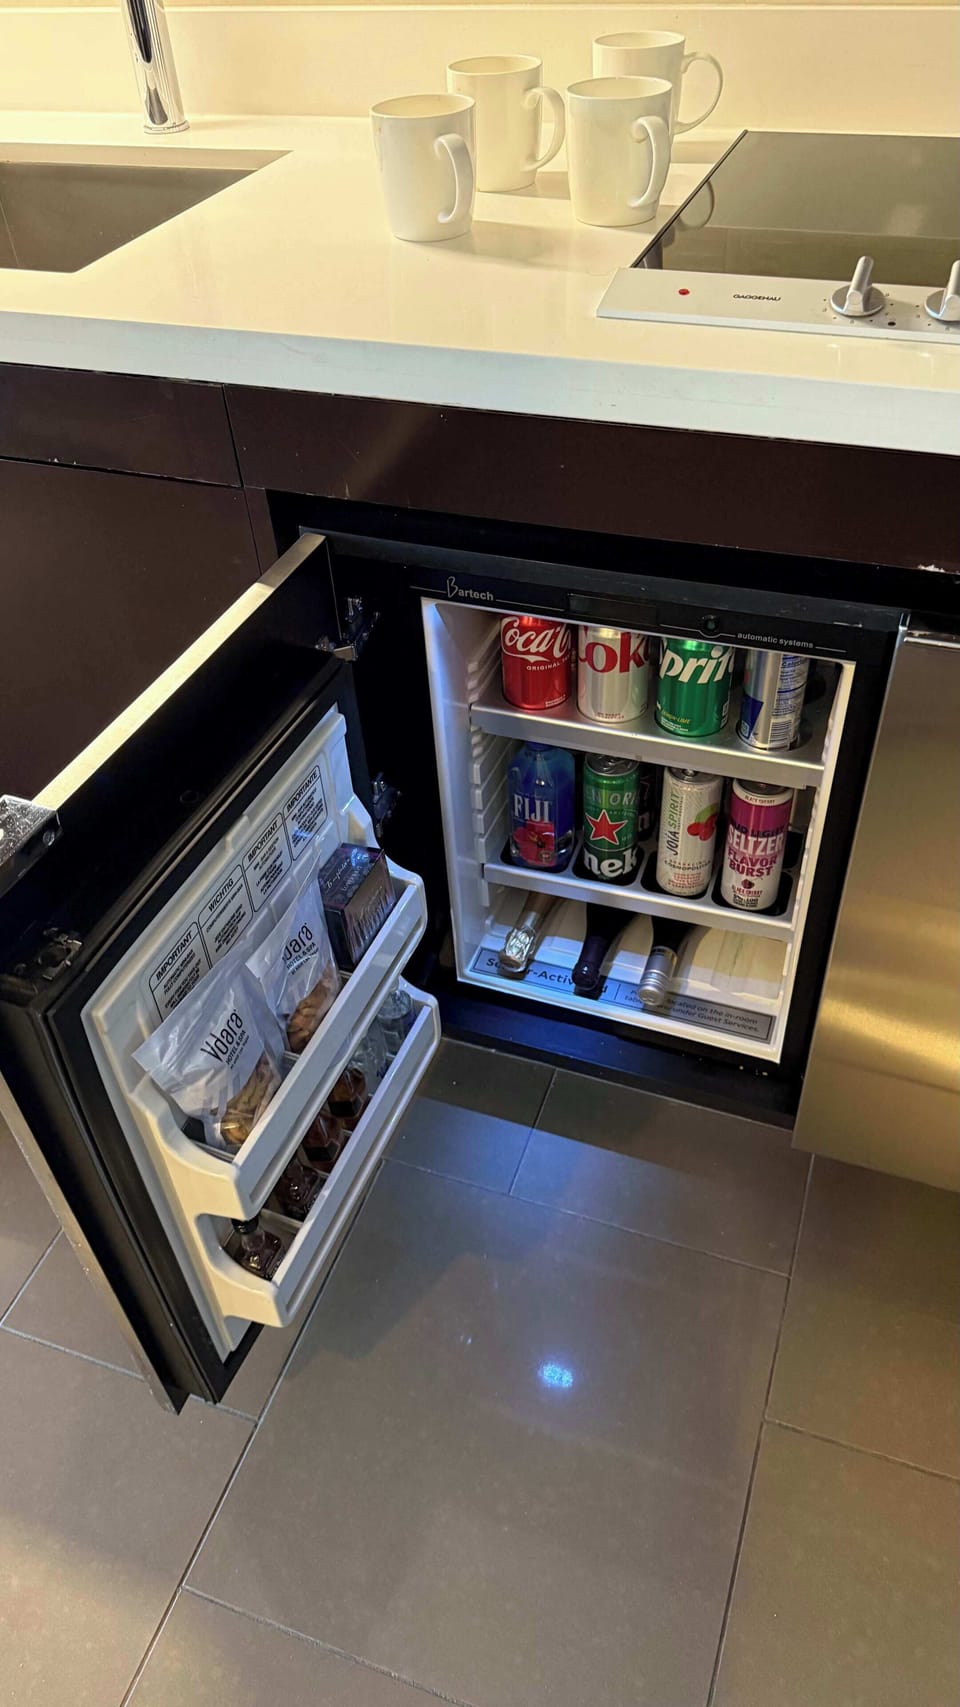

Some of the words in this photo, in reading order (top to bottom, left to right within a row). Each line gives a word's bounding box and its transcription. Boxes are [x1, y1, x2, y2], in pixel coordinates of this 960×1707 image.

[447, 576, 494, 601] Bartech
[578, 626, 649, 673] ok
[737, 632, 778, 644] automatic
[778, 639, 814, 649] systems
[526, 662, 561, 671] ORIGINAL
[659, 639, 735, 684] prit
[286, 769, 317, 813] IMPORTANTE
[513, 793, 551, 823] FIJI
[668, 791, 681, 830] SPIRIT
[247, 820, 278, 862] IMPORTANT
[728, 823, 784, 855] SELTZER
[728, 847, 777, 867] FLAVOR
[728, 859, 774, 877] BURST
[208, 878, 234, 912] WICHTIG
[155, 930, 192, 981] IMPORTANT
[709, 1007, 723, 1016] the
[200, 1011, 243, 1062] Vdara
[225, 1045, 238, 1066] HOTEL
[238, 1029, 247, 1042] SPA
